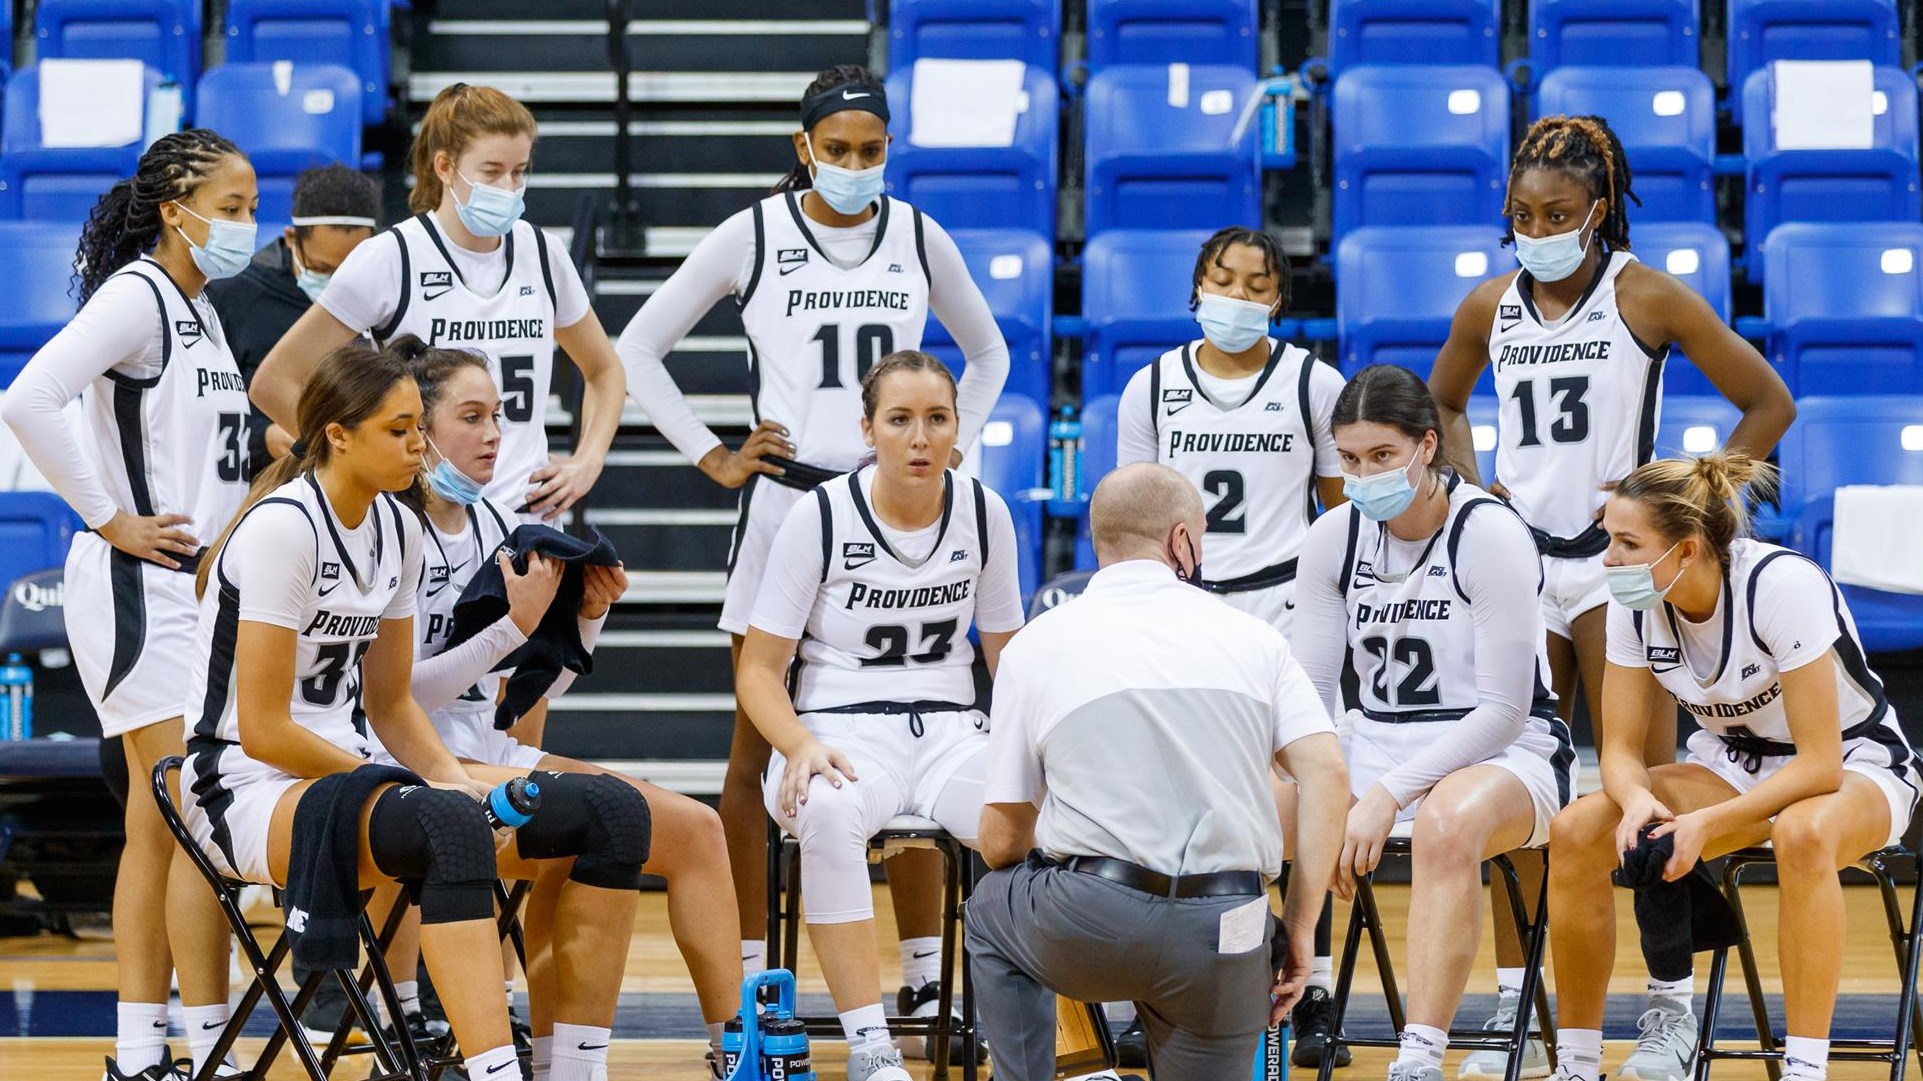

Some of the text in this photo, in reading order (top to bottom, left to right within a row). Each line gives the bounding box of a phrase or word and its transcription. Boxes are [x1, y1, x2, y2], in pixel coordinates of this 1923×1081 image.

[786, 290, 909, 317] PROVIDENCE
[428, 319, 544, 346] PROVIDENCE
[1498, 341, 1611, 372] PROVIDENCE
[1510, 375, 1591, 449] 13
[1169, 430, 1294, 459] PROVIDENCE
[1202, 469, 1246, 534] 2
[845, 578, 971, 610] PROVIDENCE
[860, 618, 958, 668] 23
[1650, 649, 1677, 659] BLM
